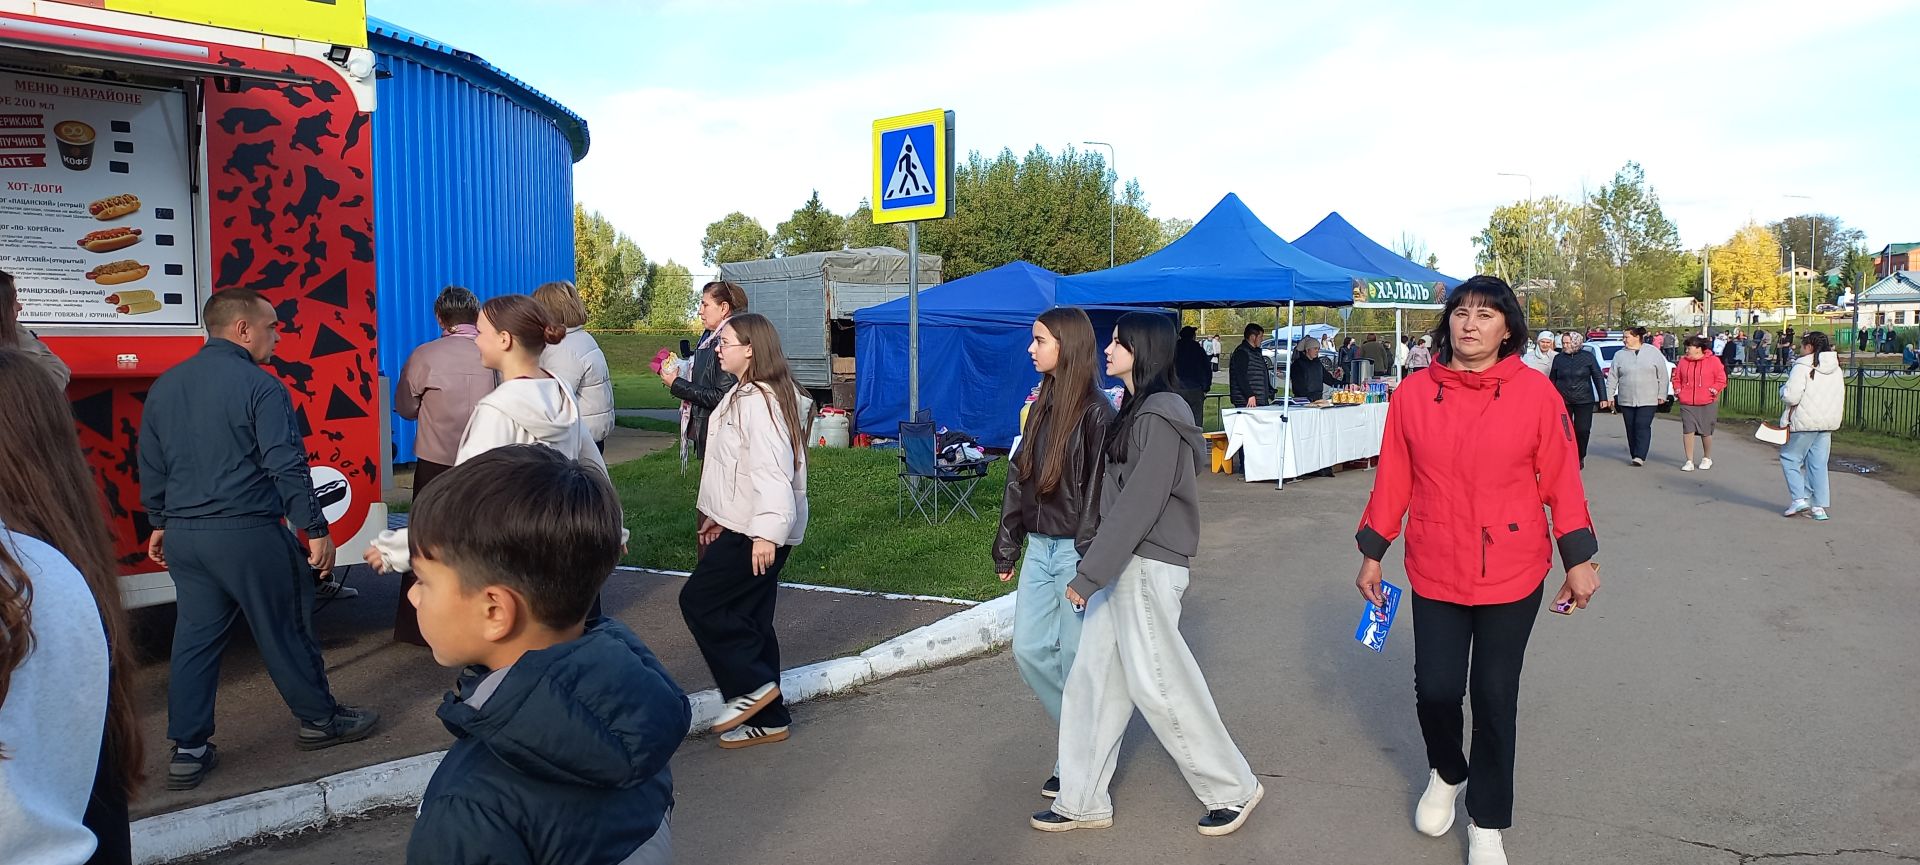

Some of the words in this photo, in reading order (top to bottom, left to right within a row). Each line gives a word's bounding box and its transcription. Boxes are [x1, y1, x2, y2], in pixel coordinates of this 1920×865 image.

[15, 79, 59, 95] МЕНЮ
[63, 86, 142, 104] #НАРАЙОНЕ
[15, 97, 36, 107] 200
[39, 102, 55, 111] мл
[63, 155, 89, 166] КОФЕ
[7, 181, 63, 194] ХОТ-ДОГИ
[1375, 281, 1429, 300] ХАЛЯЛЬ
